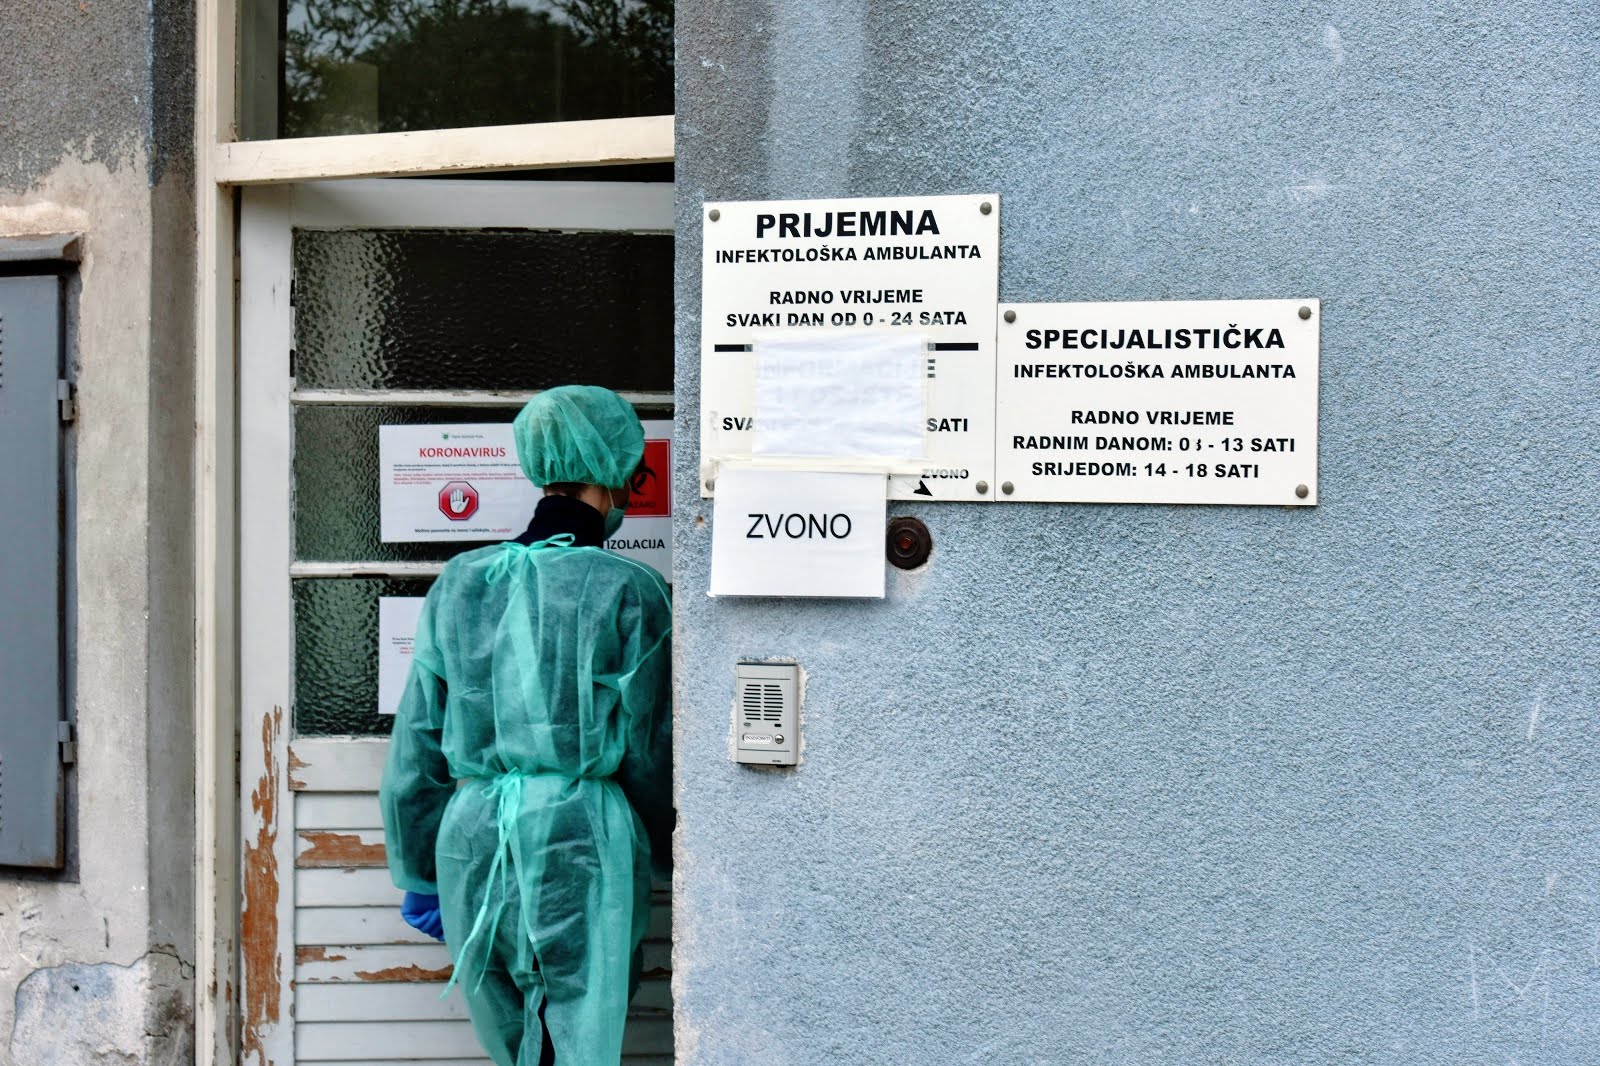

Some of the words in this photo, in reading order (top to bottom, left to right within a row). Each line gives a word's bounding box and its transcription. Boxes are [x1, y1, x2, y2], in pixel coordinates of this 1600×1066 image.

[756, 210, 940, 239] PRIJEMNA
[716, 245, 857, 264] INFEKTOLOŠKA
[863, 245, 982, 260] AMBULANTA
[769, 290, 833, 304] RADNO
[840, 289, 923, 303] VRIJEME
[726, 313, 780, 327] SVAKI
[787, 312, 824, 326] DAN
[831, 312, 857, 326] OD
[863, 312, 873, 326] 0
[891, 311, 913, 325] 24
[919, 311, 968, 325] SATA
[1025, 324, 1285, 349] SPECIJALISTIČKA
[1014, 361, 1164, 378] INFEKTOLOŠKA
[1171, 364, 1297, 379] AMBULANTA
[926, 418, 969, 432] SATI
[1071, 411, 1139, 424] RADNO
[1146, 411, 1234, 425] VRIJEME
[1013, 436, 1088, 449] RADNIM
[1096, 437, 1172, 450] DANOM:
[1222, 438, 1243, 451] 13
[1251, 438, 1295, 452] SATI
[419, 447, 506, 458] KORONAVIRUS
[921, 468, 969, 479] ZVONO
[1031, 462, 1137, 477] SRIJEDOM:
[1144, 463, 1166, 476] 14
[1185, 464, 1208, 477] 18
[1214, 464, 1259, 478] SATI
[746, 513, 852, 539] ZVONO
[606, 538, 666, 550] IZOLACIJA
